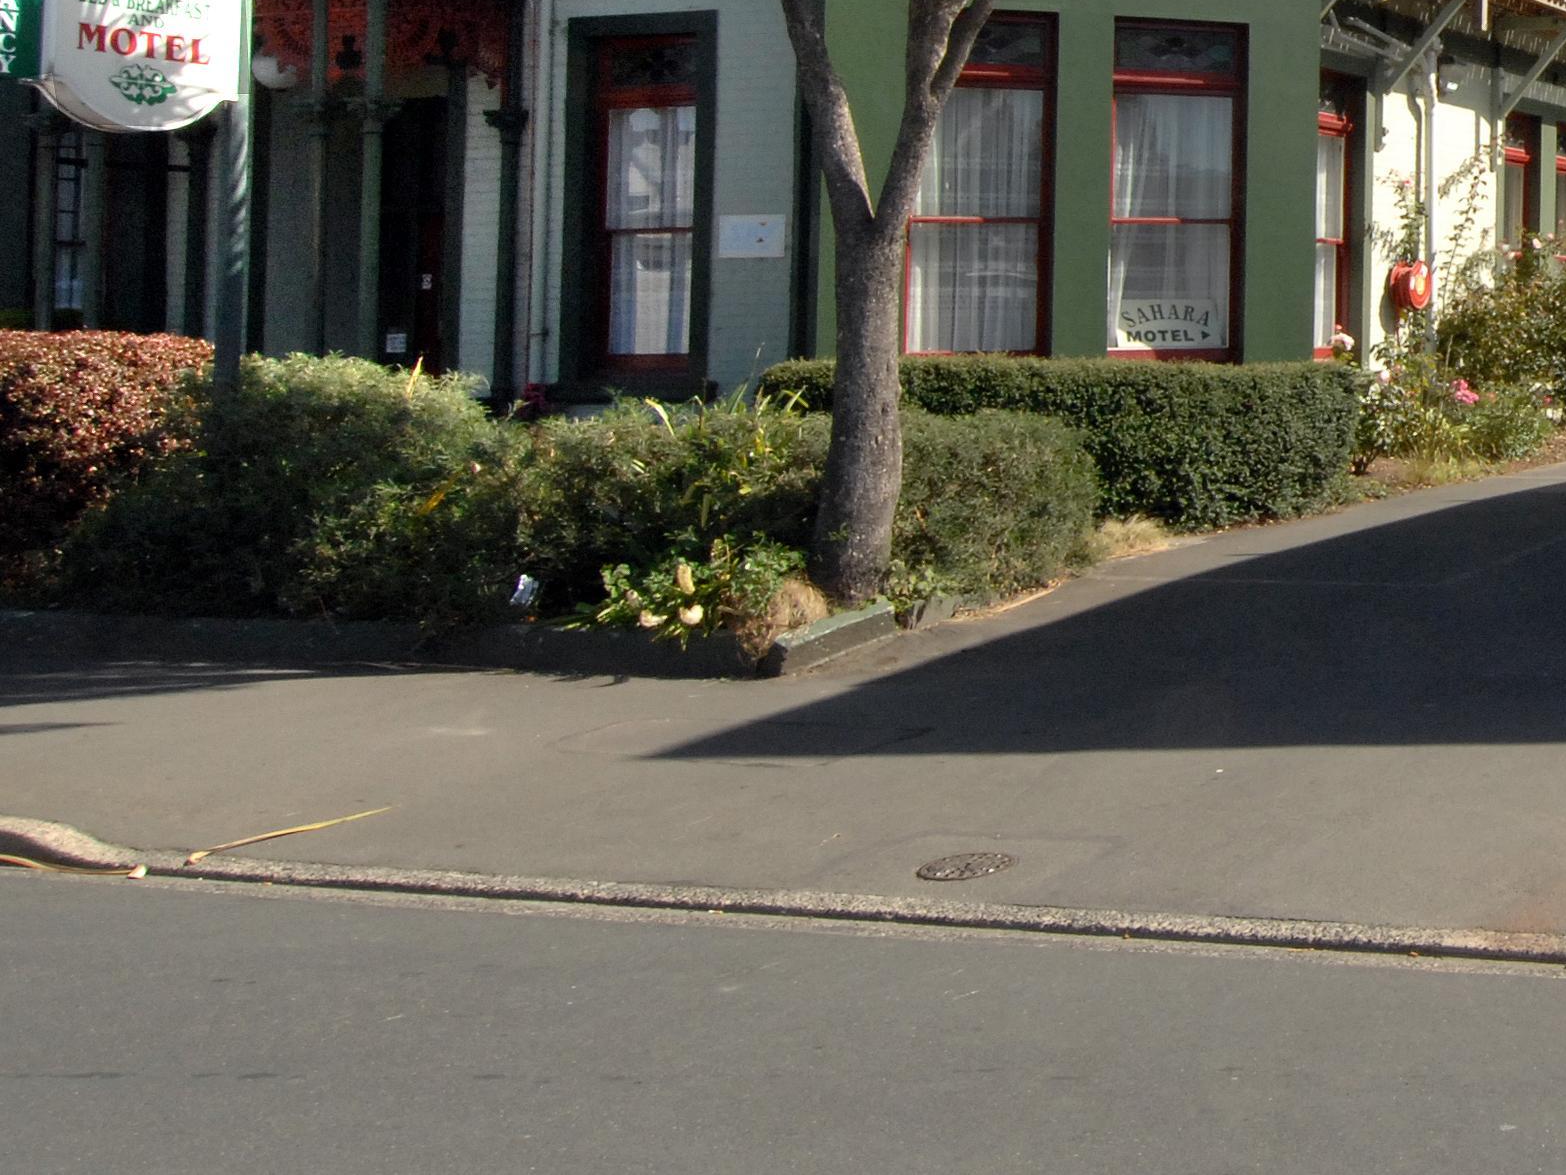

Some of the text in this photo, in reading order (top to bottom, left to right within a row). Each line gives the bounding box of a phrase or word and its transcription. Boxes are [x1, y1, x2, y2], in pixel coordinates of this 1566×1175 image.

[128, 13, 165, 29] AND
[77, 22, 210, 65] MOTEL
[1121, 304, 1210, 327] SAHARA
[1126, 329, 1195, 342] MOTEL
